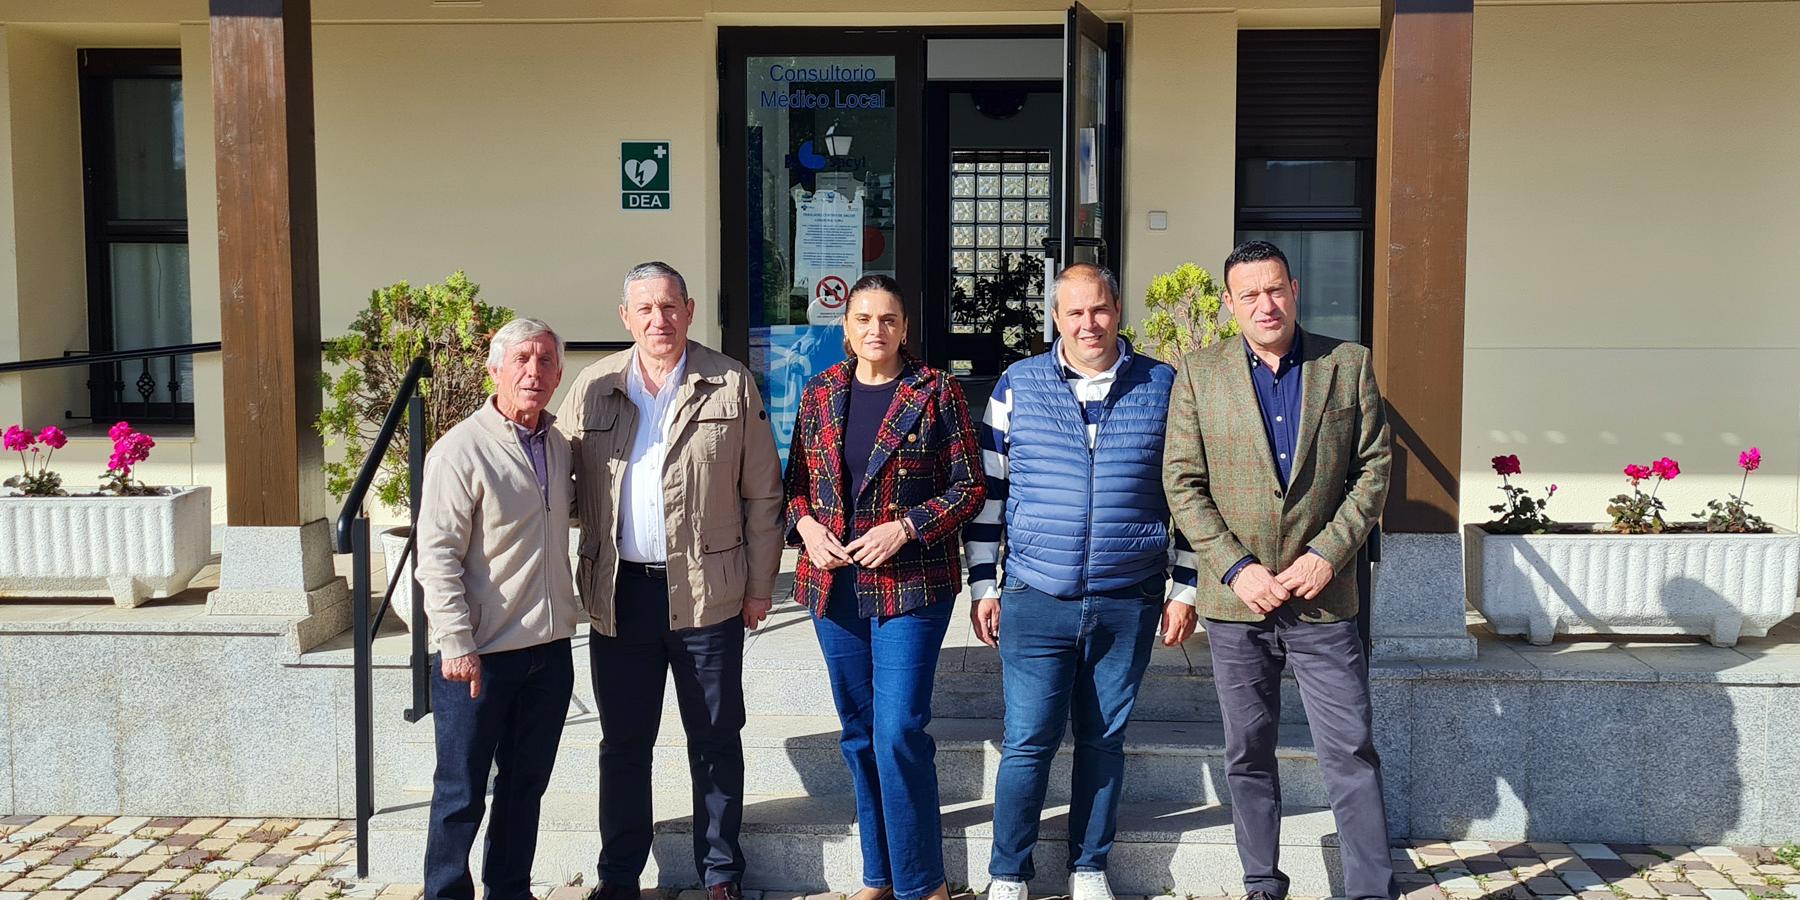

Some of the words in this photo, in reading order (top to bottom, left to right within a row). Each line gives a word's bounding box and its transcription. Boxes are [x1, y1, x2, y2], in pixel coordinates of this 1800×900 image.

[769, 64, 876, 82] Consultorio
[760, 89, 830, 109] Médico
[834, 89, 886, 109] Local
[629, 194, 662, 207] DEA
